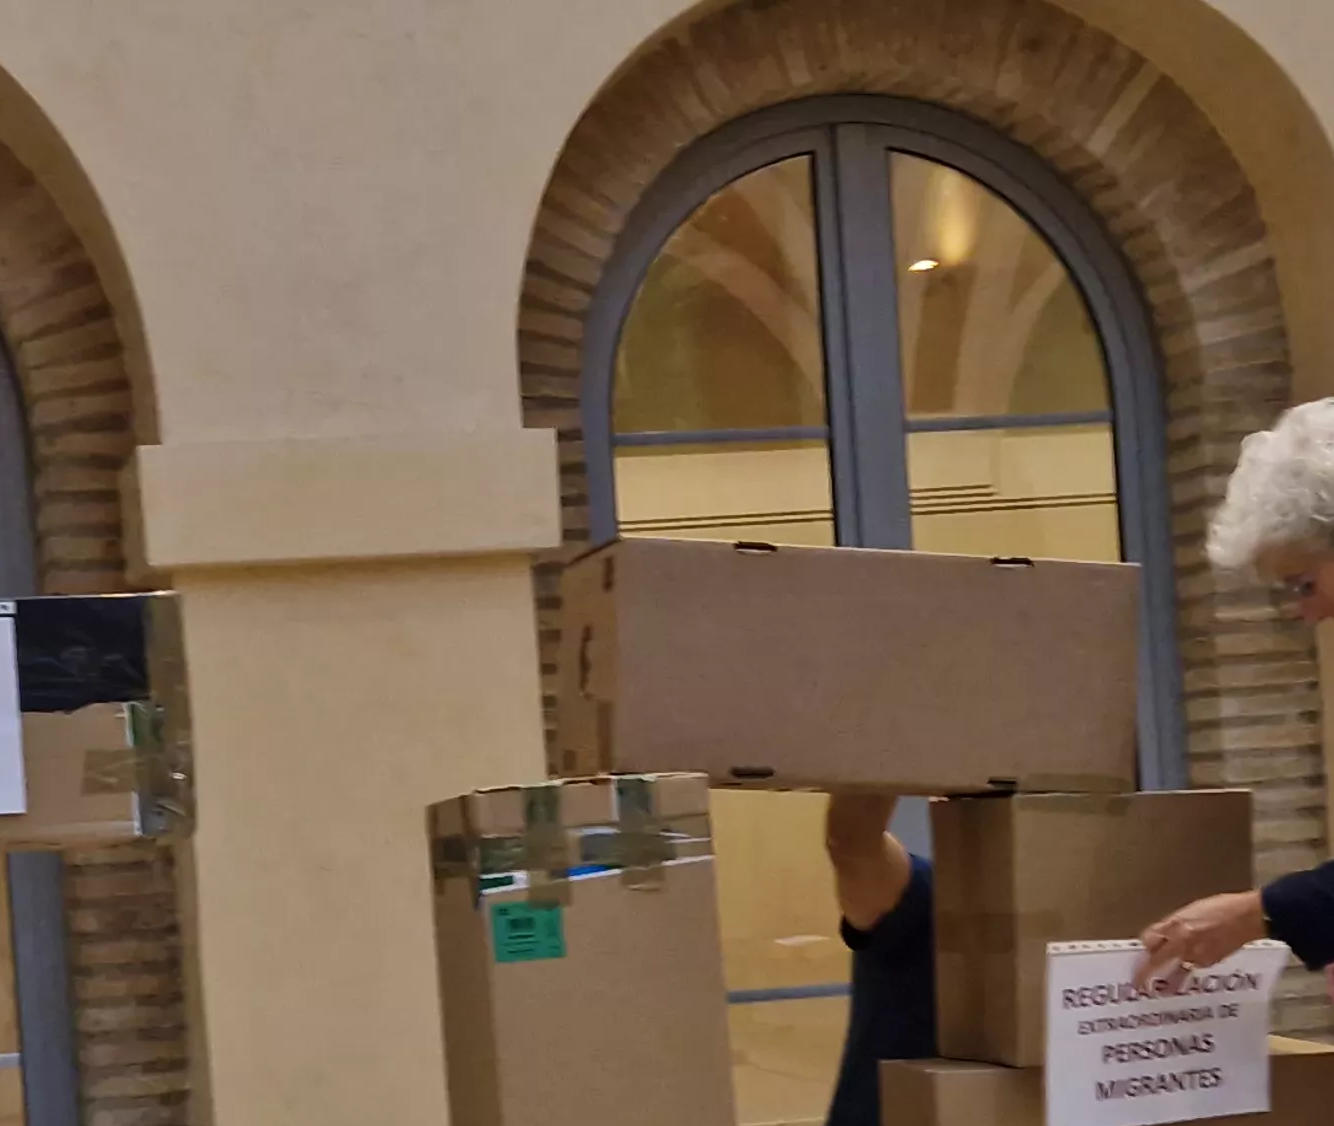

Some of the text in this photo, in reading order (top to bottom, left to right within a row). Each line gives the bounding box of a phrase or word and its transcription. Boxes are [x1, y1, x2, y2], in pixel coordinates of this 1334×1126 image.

[1218, 1002, 1240, 1019] DE
[1101, 1033, 1215, 1065] PERSONAS
[1095, 1067, 1223, 1101] MIGRANTES
